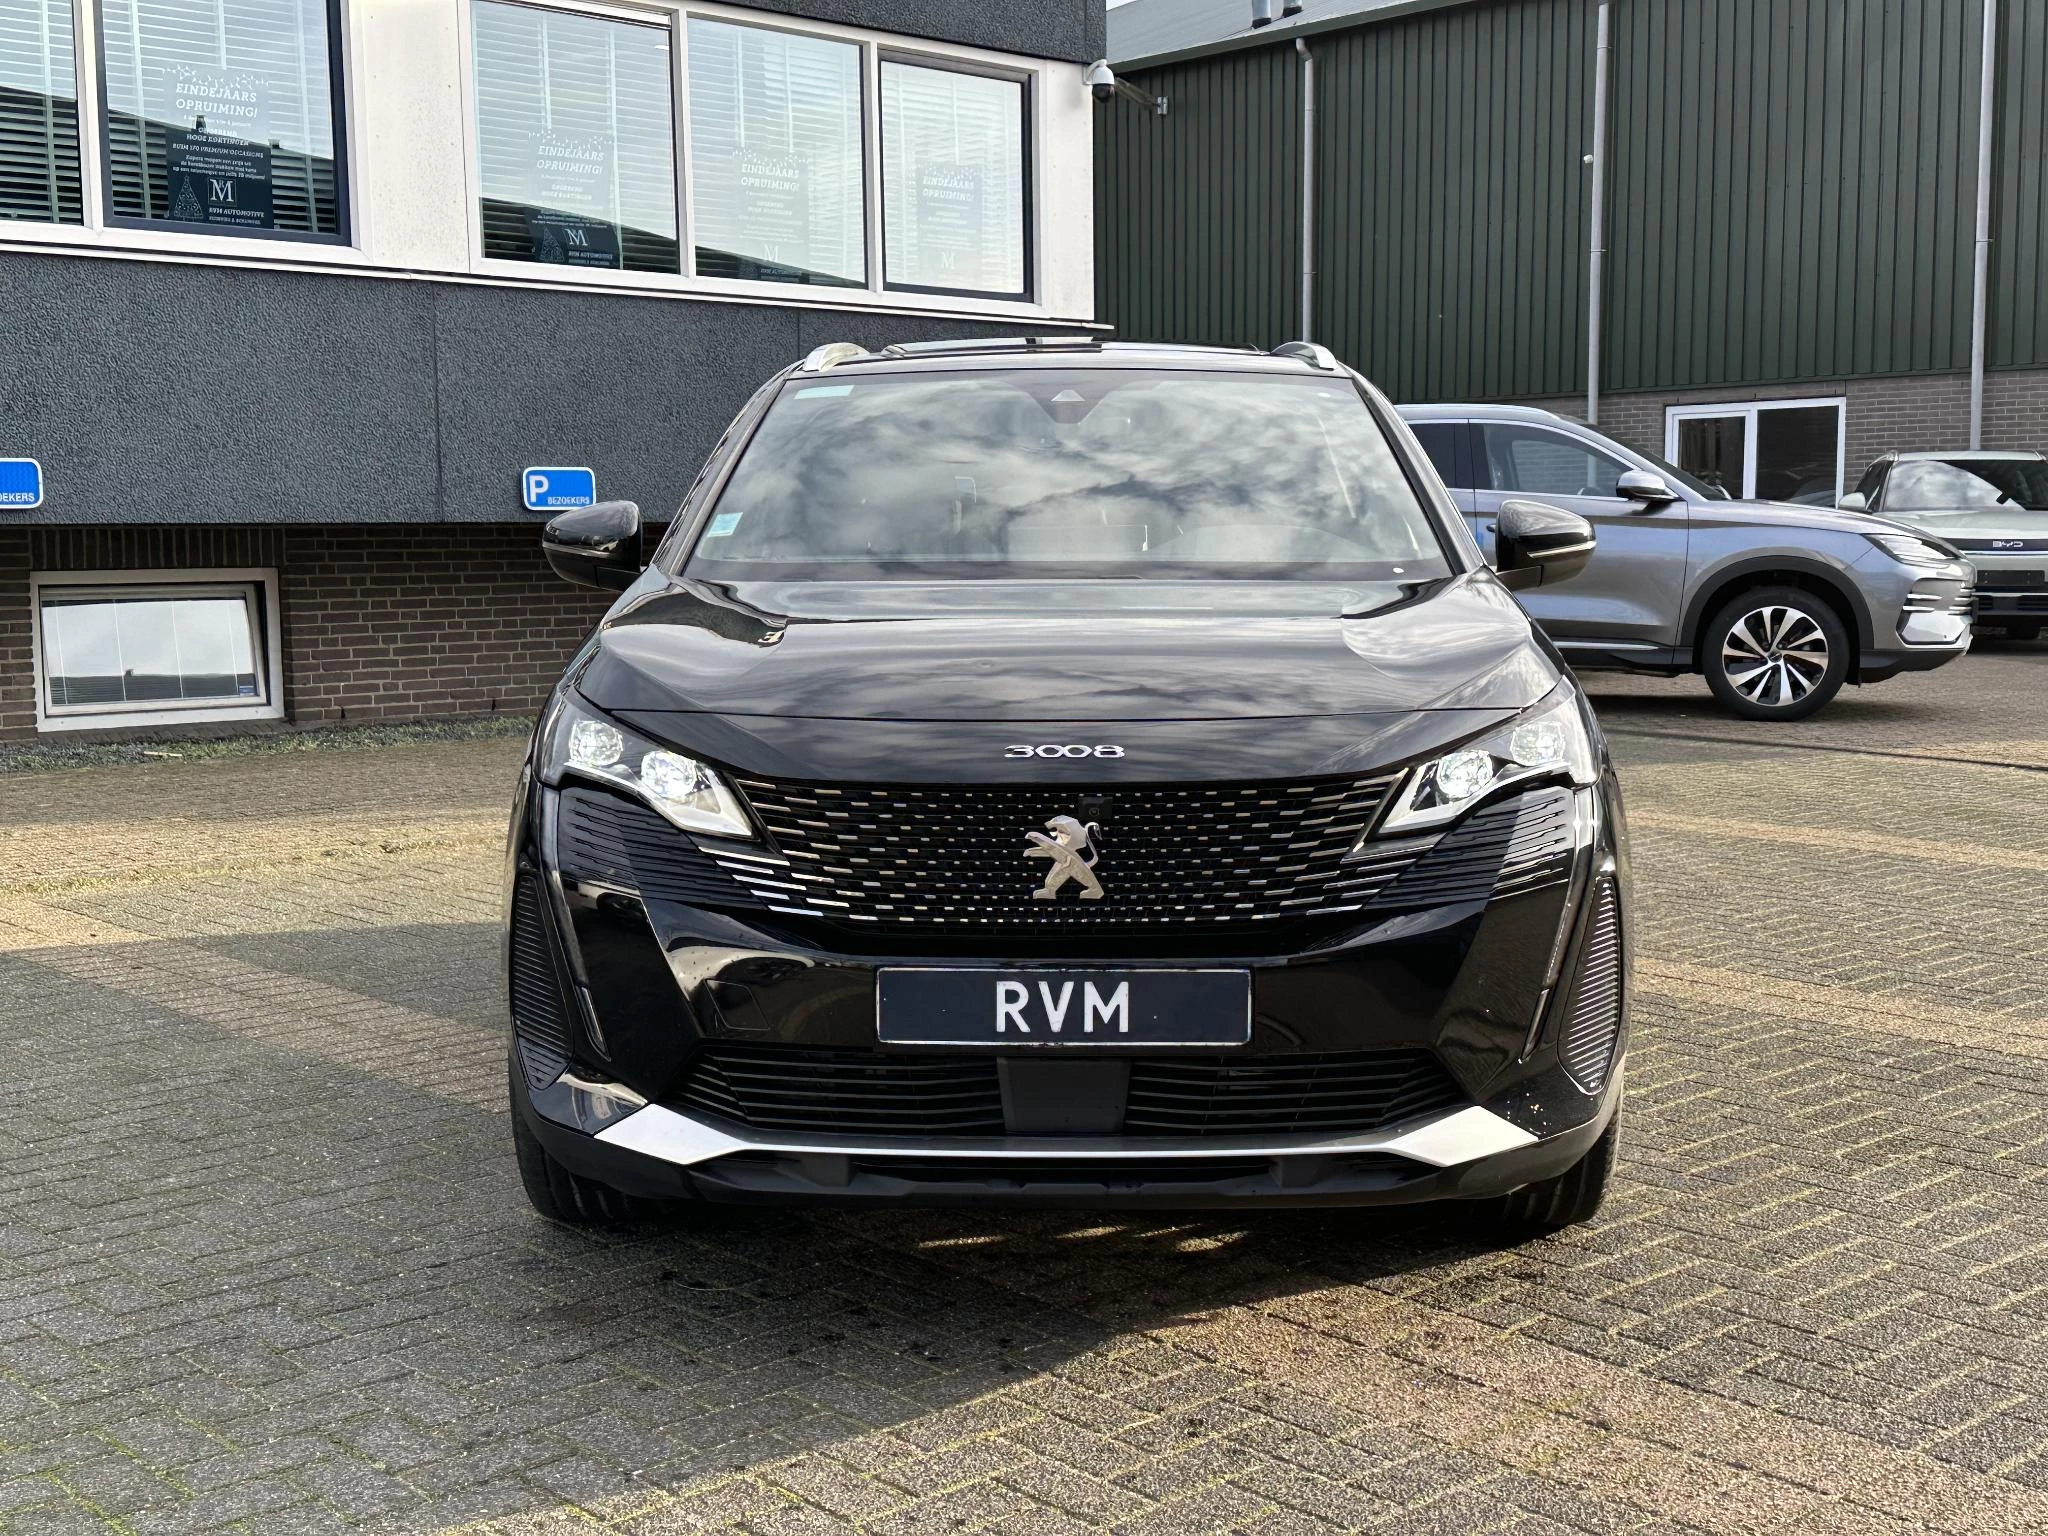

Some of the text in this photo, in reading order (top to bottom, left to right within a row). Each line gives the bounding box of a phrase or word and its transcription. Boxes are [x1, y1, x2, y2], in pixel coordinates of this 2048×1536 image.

[175, 82, 257, 103] EINDEJAARS
[175, 98, 258, 118] OPRUIMING!
[537, 145, 605, 161] EINDEJAARS
[536, 159, 604, 176] OPRUIMING!
[741, 163, 800, 179] EINDEJAARS
[529, 474, 549, 502] P
[547, 496, 590, 505] BEZOEKERS
[1992, 540, 2024, 548] BYD
[1003, 744, 1126, 758] 3008
[995, 980, 1129, 1033] RVM
